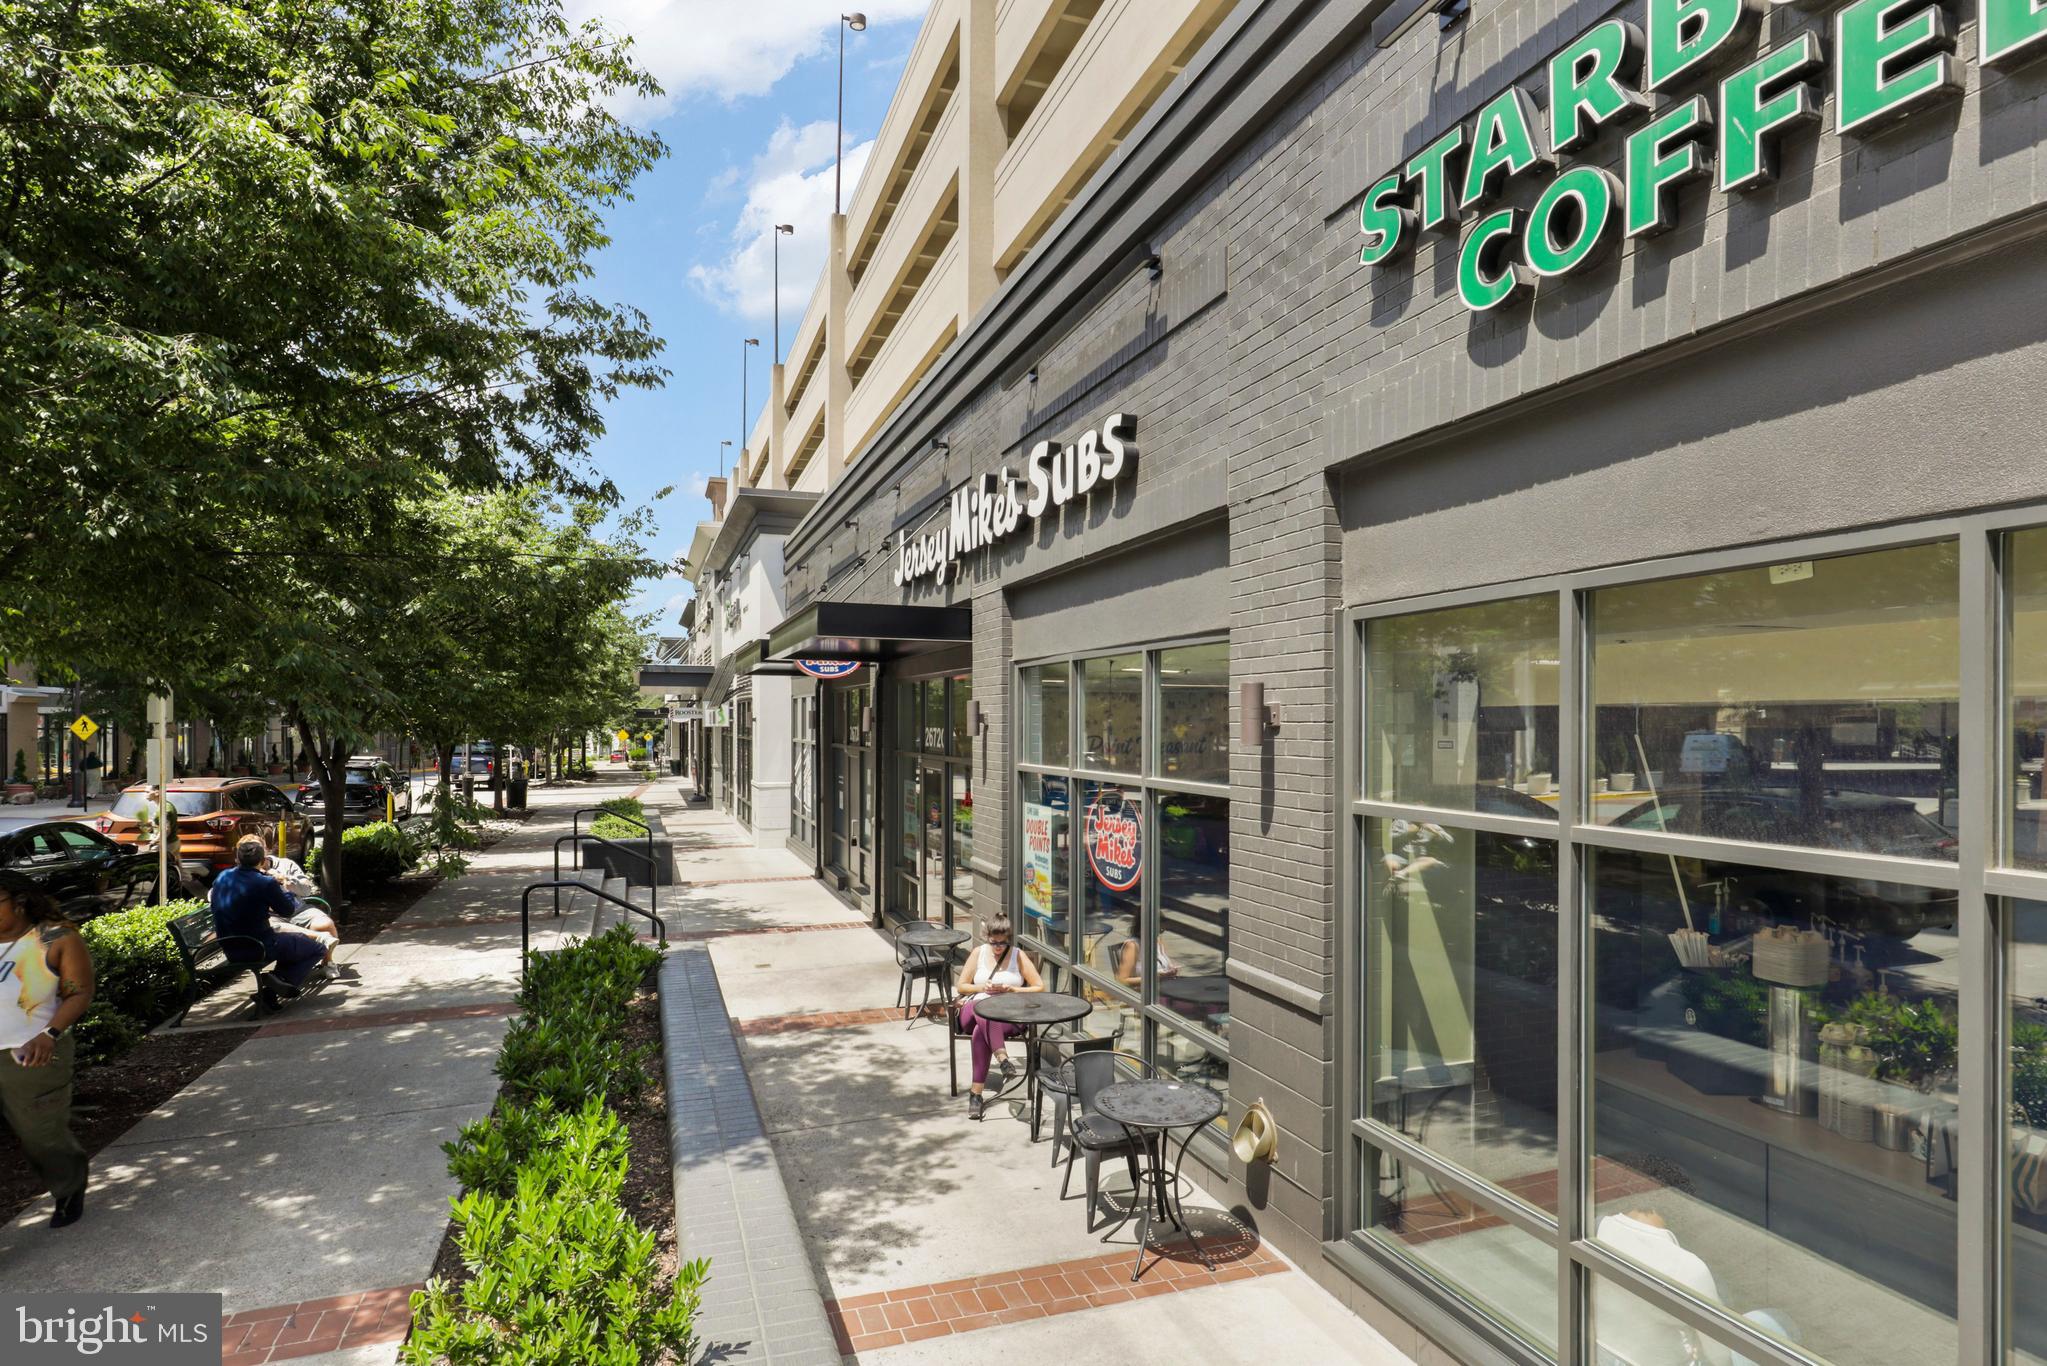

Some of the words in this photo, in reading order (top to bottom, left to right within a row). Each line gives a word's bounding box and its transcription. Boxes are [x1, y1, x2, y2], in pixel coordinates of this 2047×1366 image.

[1359, 0, 1805, 266] STARB
[894, 529, 950, 587] Jersey
[949, 465, 1022, 560] Mike's
[1027, 413, 1124, 518] SUBS
[1025, 818, 1048, 836] DOUBLE
[1095, 805, 1136, 848] Jersey
[1029, 835, 1050, 854] POINTS
[1106, 866, 1122, 880] SUBS
